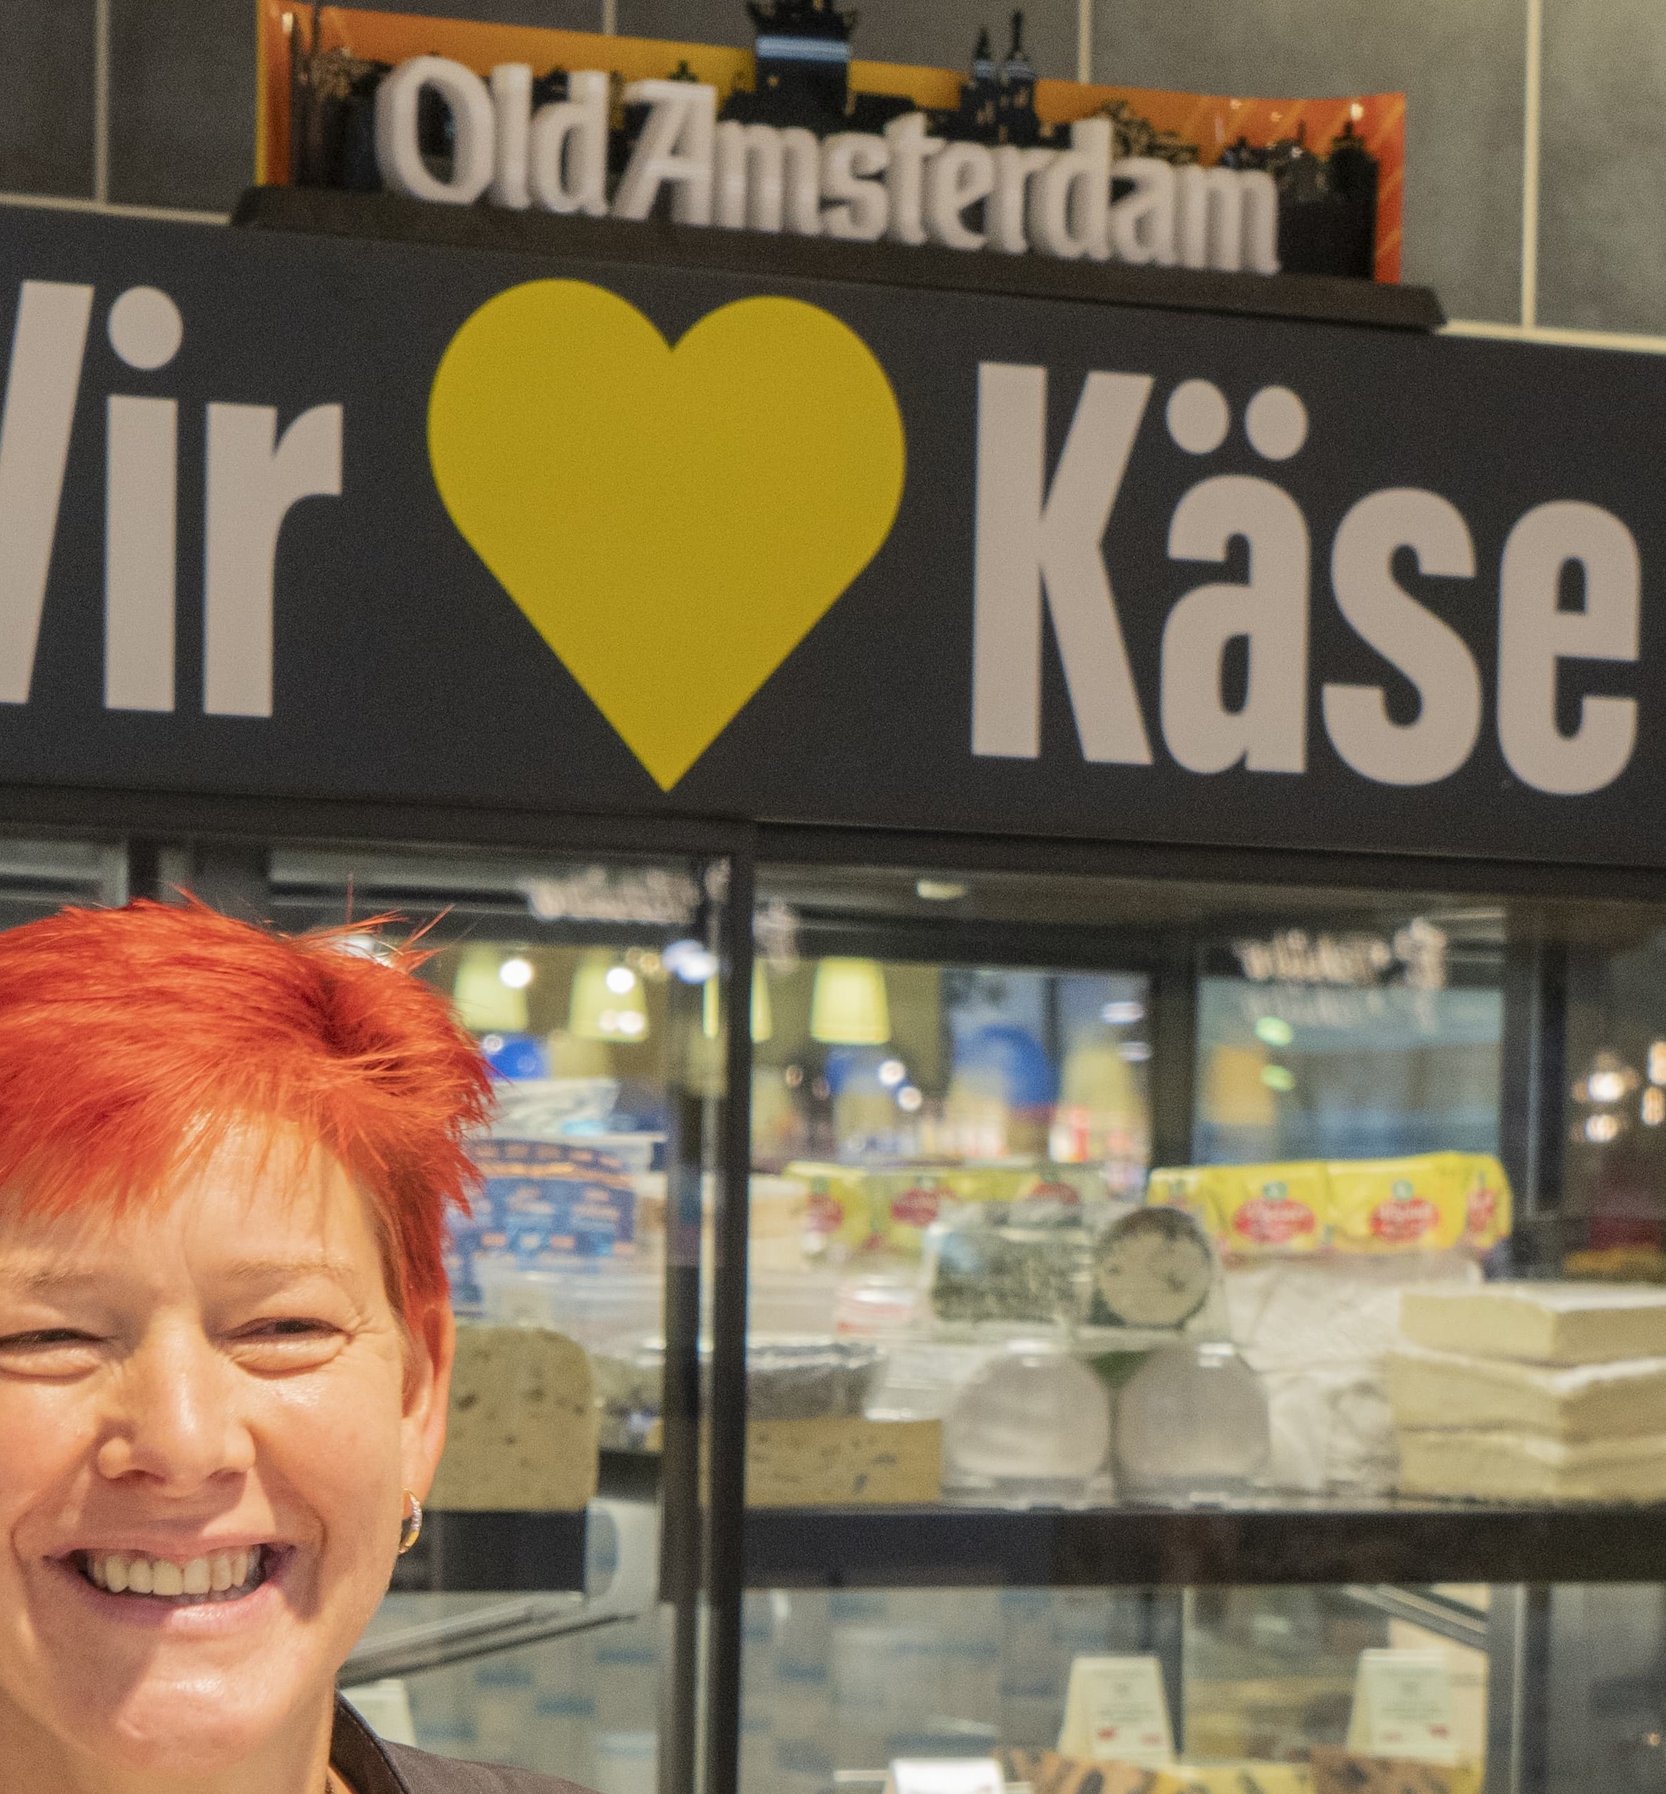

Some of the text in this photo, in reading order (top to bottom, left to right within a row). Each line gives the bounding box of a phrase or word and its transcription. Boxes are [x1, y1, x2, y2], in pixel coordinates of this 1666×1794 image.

[373, 54, 1281, 276] Old Amsterdam
[972, 362, 1641, 796] Käse
